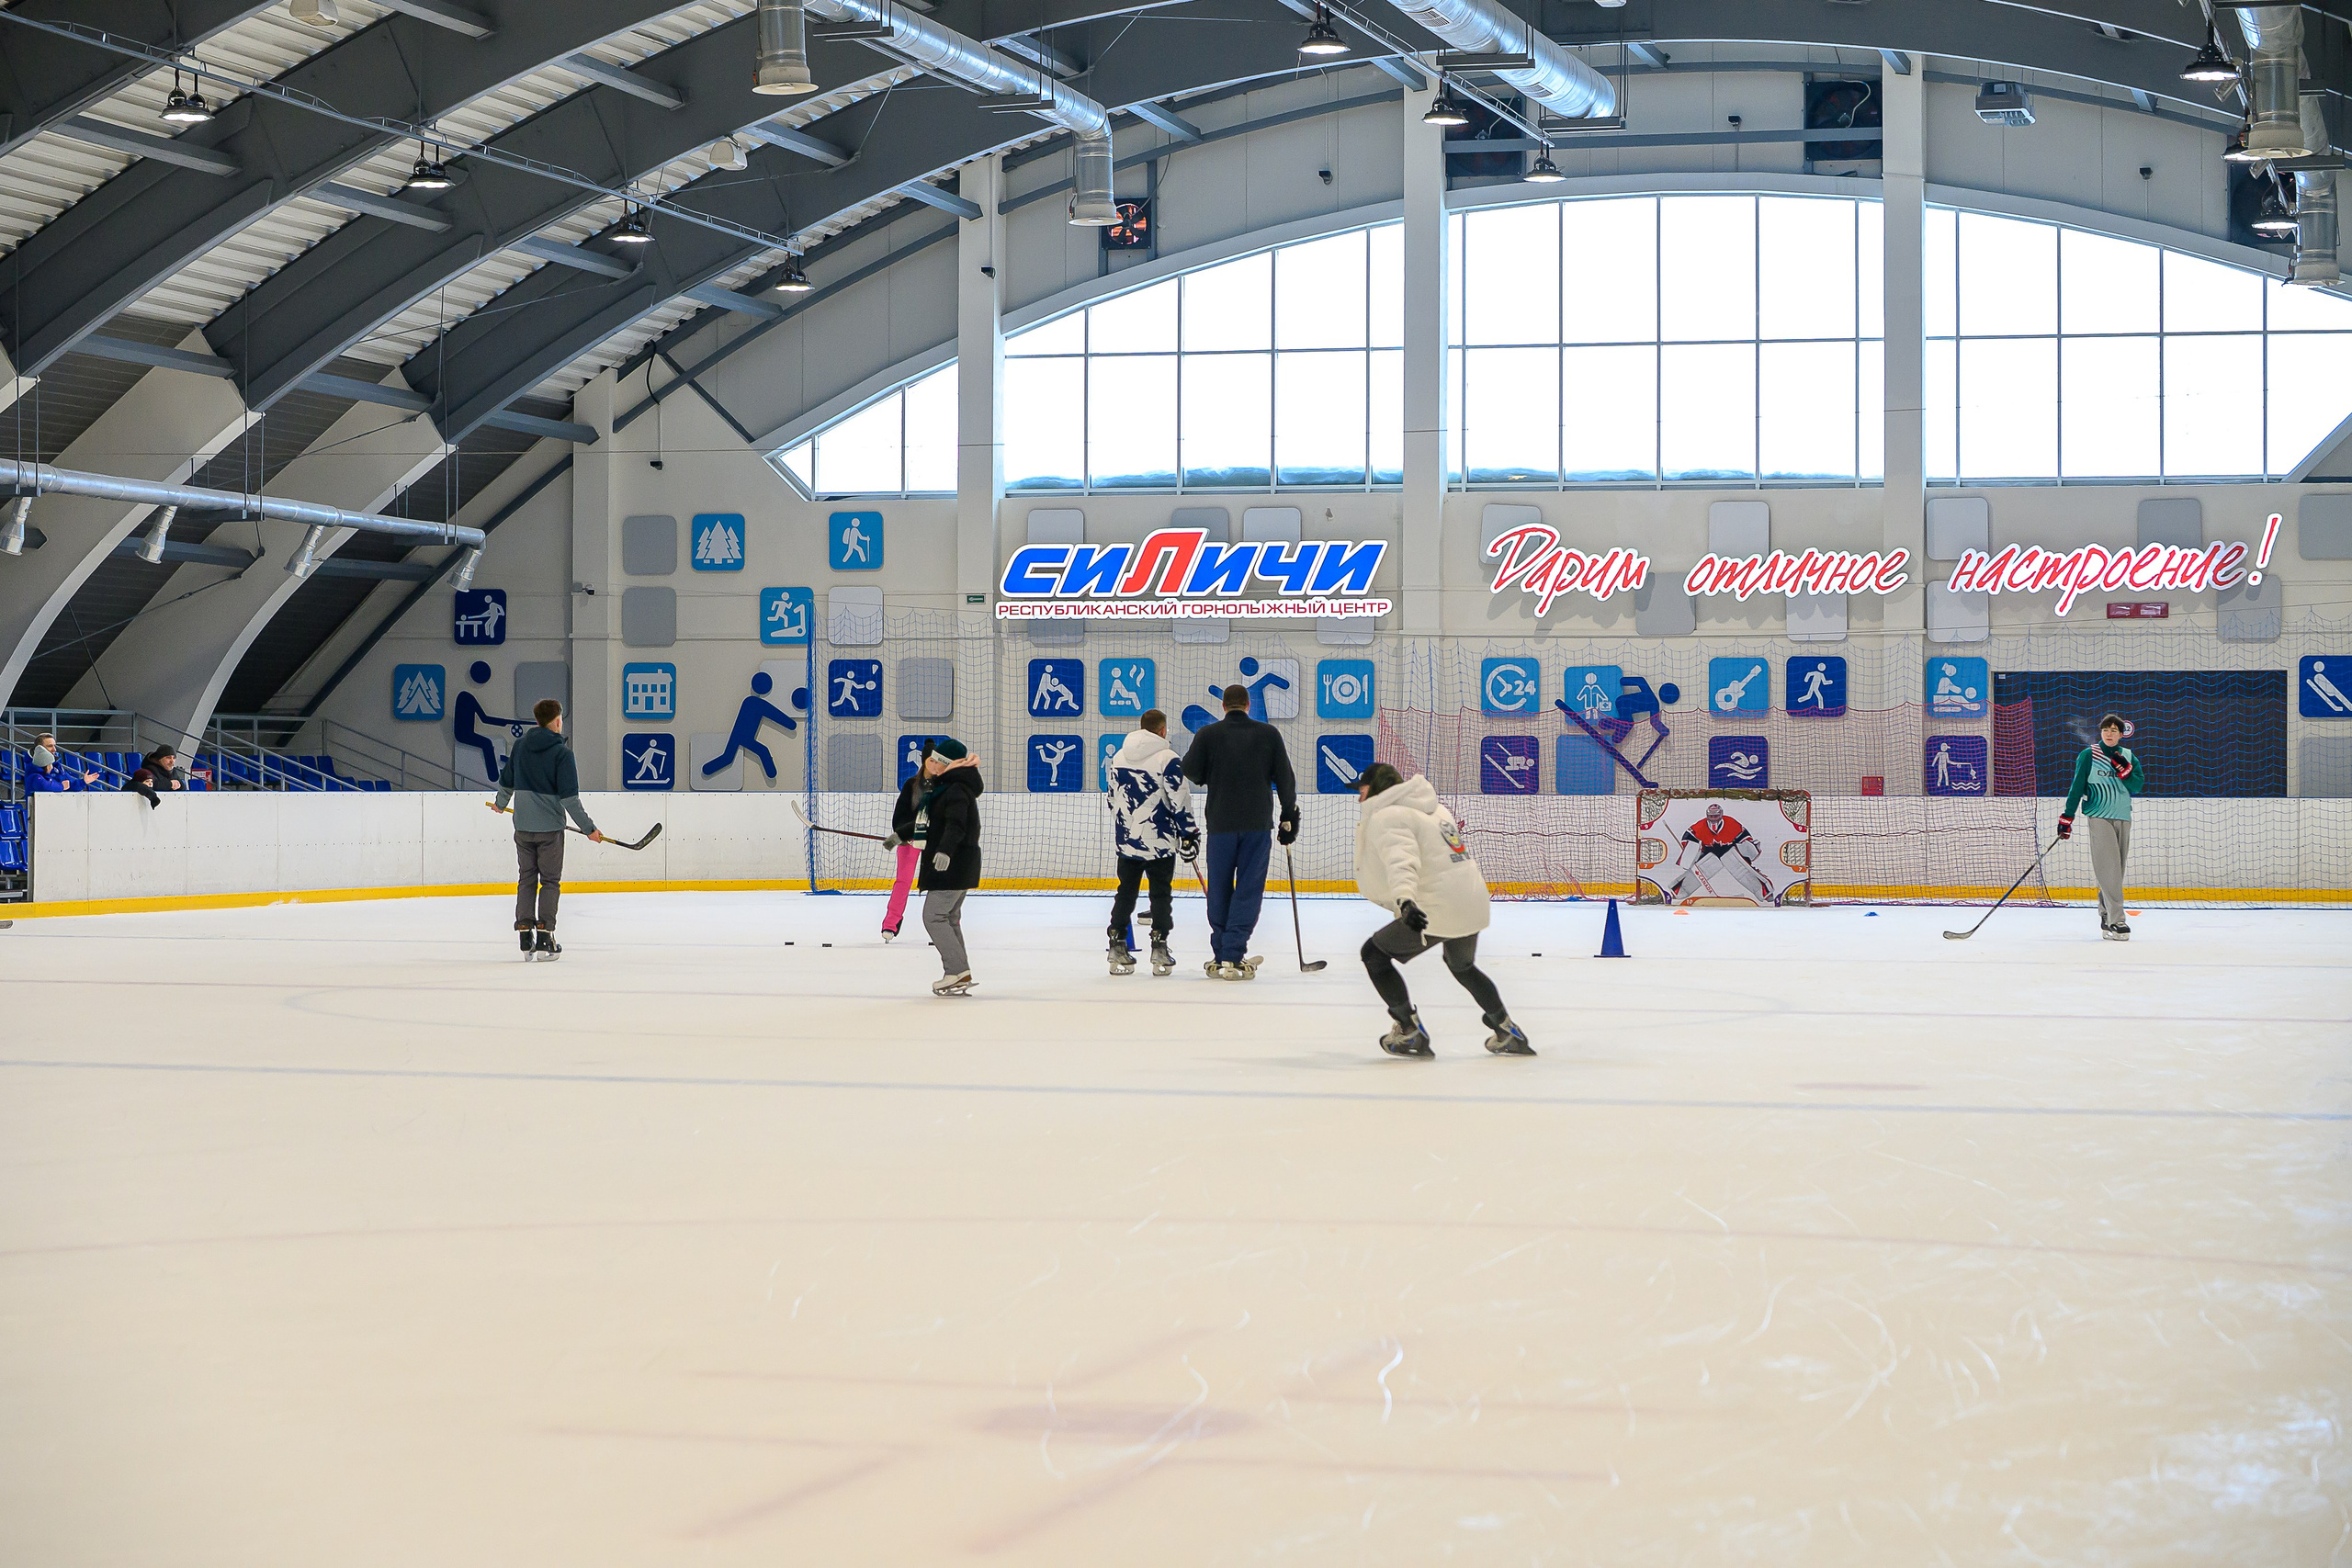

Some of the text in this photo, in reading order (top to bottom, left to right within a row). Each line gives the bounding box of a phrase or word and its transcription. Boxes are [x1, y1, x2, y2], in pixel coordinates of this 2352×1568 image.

[1487, 516, 2280, 616] Дарим отличное настроение!
[998, 599, 1388, 617] РЕСПУБЛИКАНСКИЙ ГОРНОЛЫЖНЫЙ ЦЕНТР
[1513, 680, 1536, 695] 24
[1698, 874, 1713, 895] CANADA
